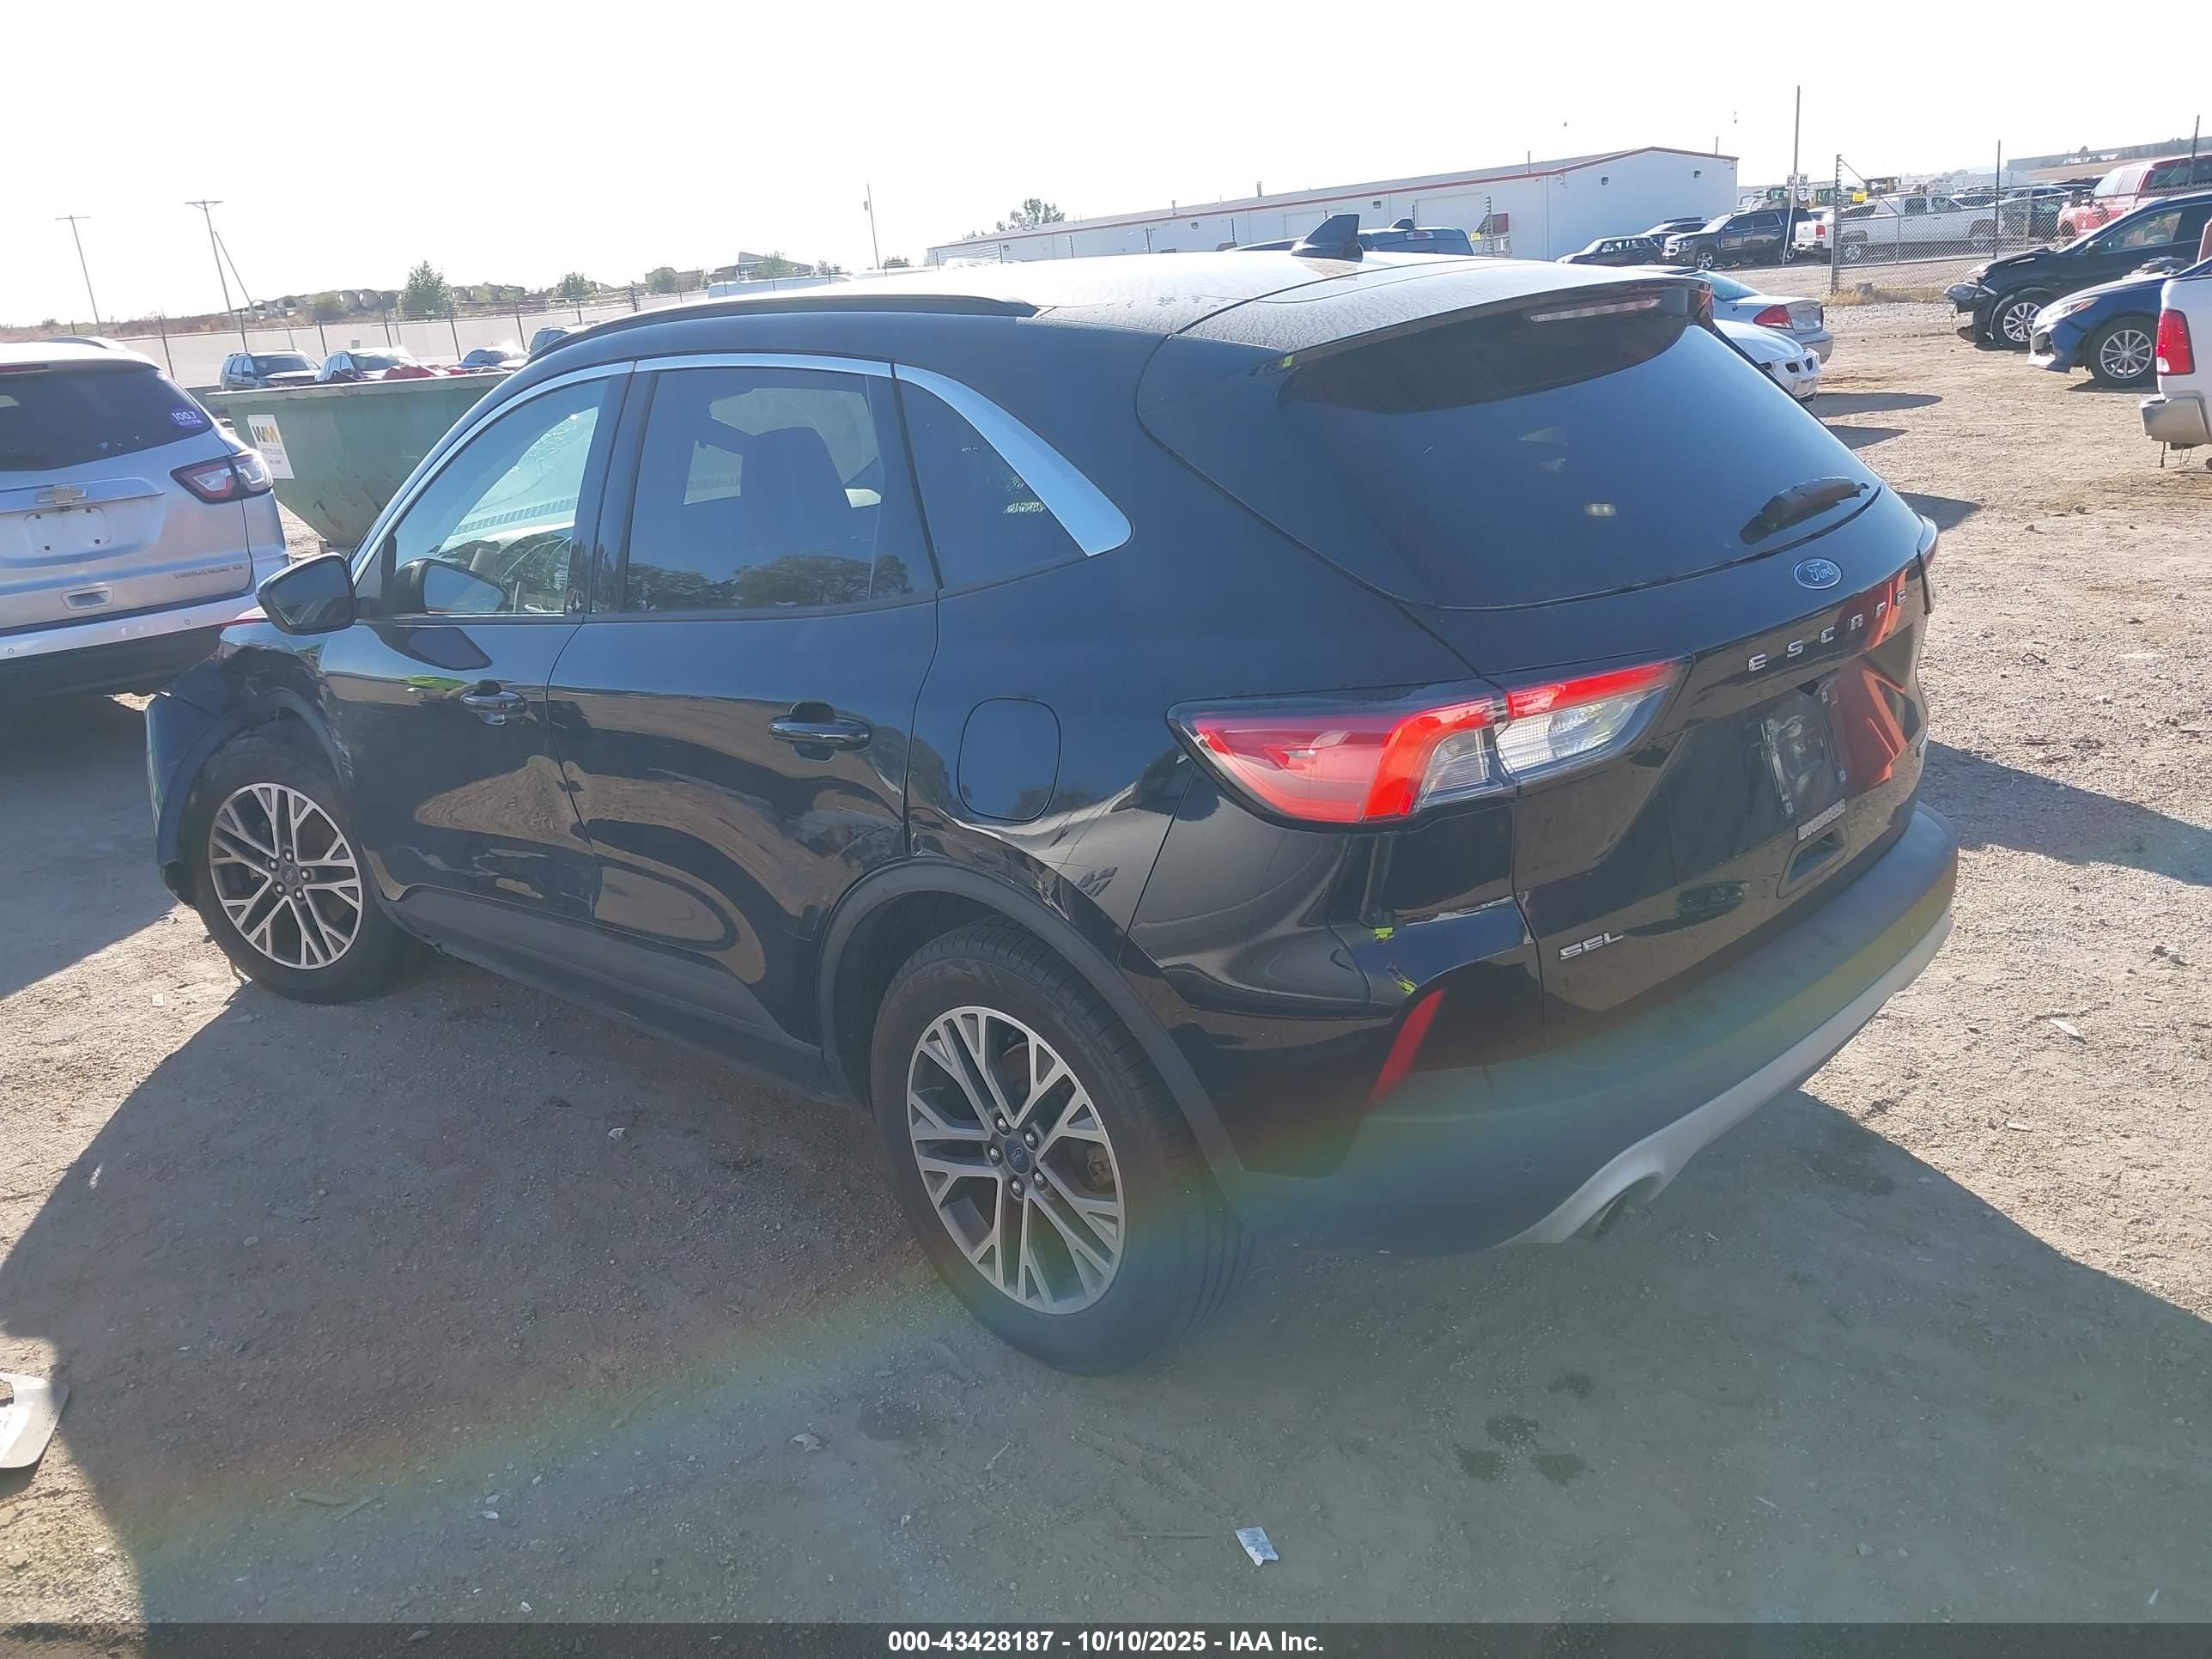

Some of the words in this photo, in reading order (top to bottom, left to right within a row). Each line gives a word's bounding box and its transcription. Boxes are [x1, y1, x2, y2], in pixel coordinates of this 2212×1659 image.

[171, 410, 197, 421] 100.7
[251, 425, 281, 443] WM
[1806, 562, 1835, 581] Ford
[1748, 590, 1907, 672] ESCAPE
[1559, 932, 1625, 962] SEL
